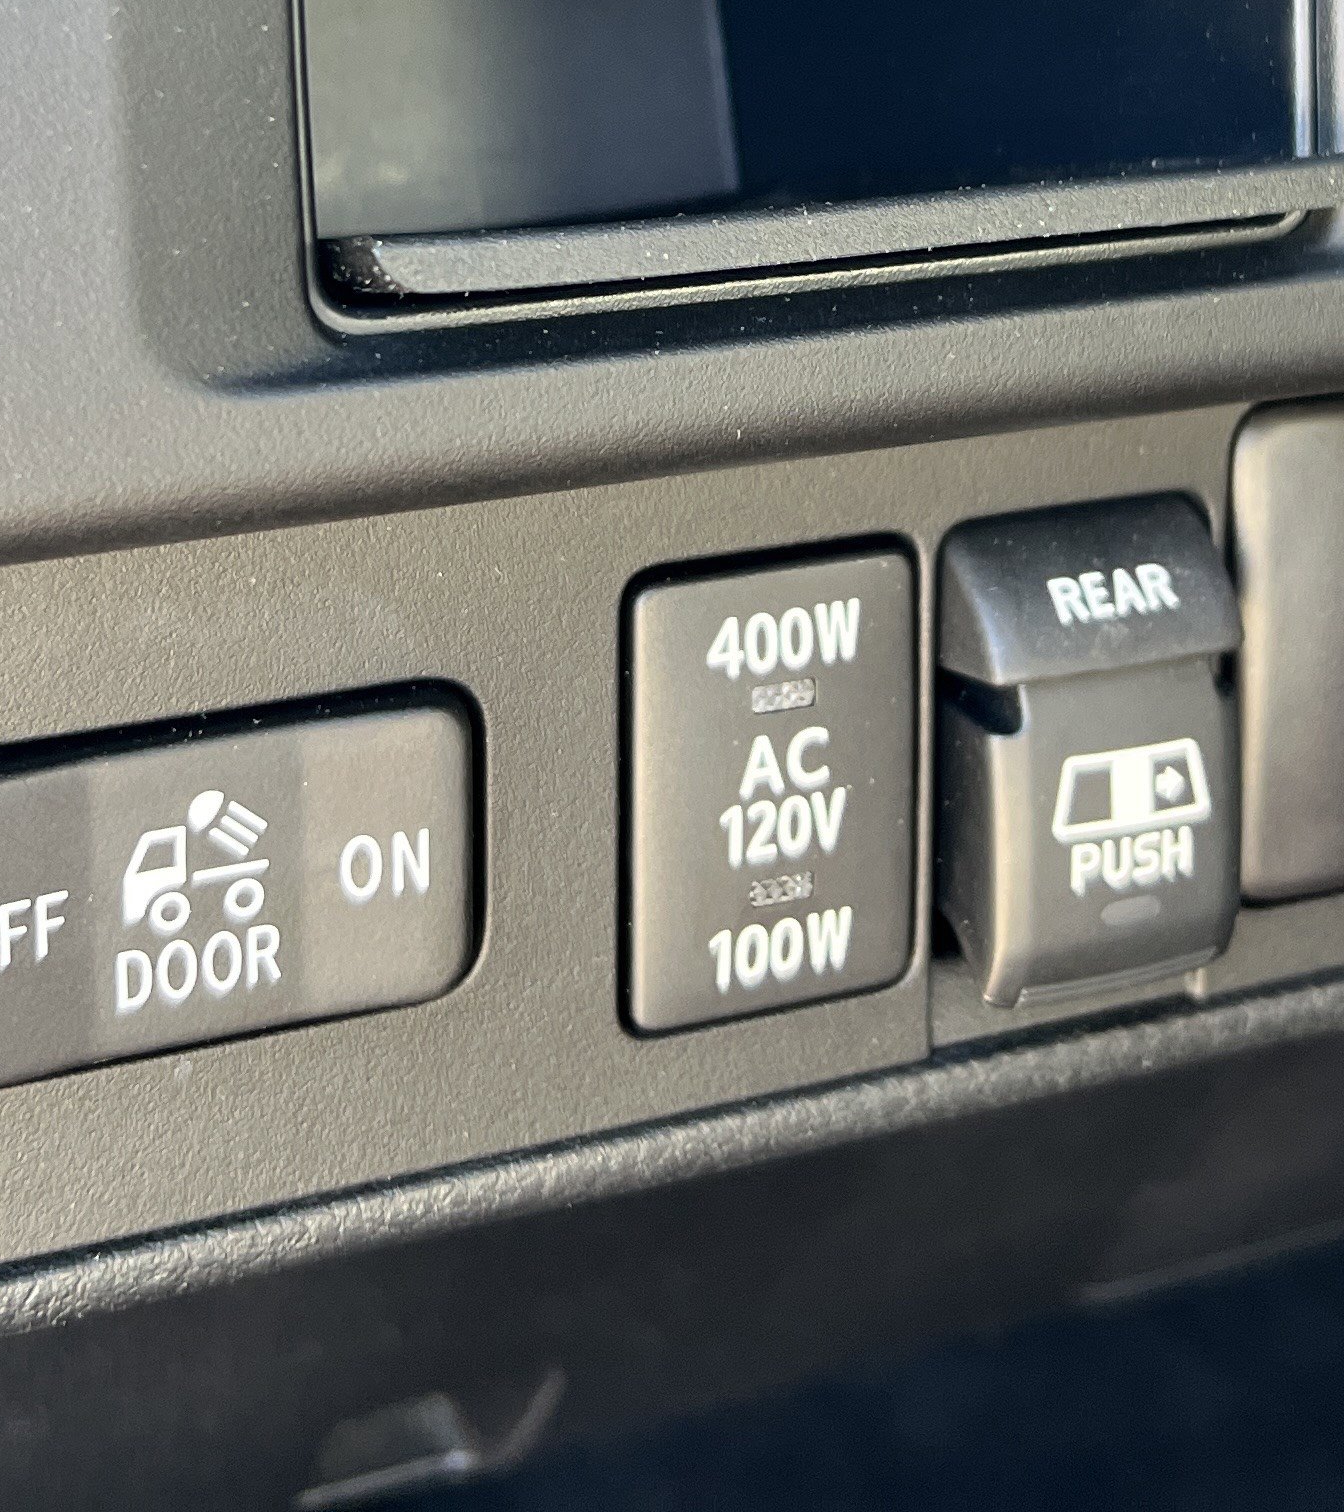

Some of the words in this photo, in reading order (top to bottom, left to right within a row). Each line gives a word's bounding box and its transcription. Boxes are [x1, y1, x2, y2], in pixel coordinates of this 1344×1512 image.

[1046, 562, 1181, 627] REAR
[706, 597, 861, 679] 400W
[739, 726, 831, 801] AC
[339, 827, 431, 903] ON
[719, 786, 846, 868] 120V
[1069, 825, 1194, 897] PUSH
[114, 923, 282, 1015] DOOR
[708, 905, 854, 993] 100W
